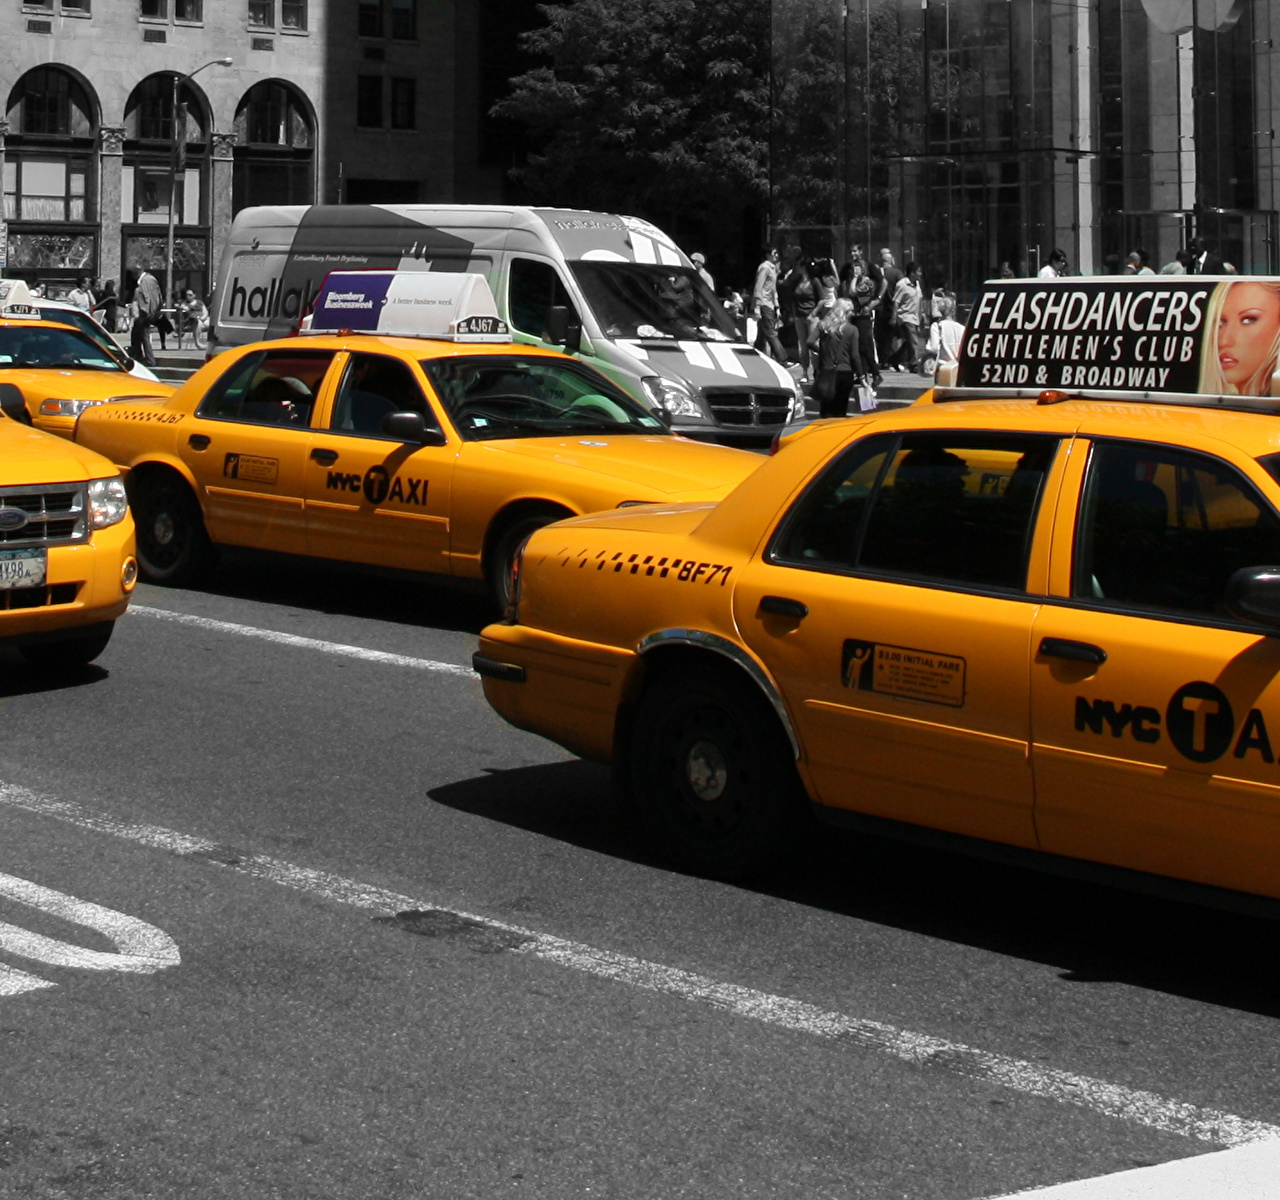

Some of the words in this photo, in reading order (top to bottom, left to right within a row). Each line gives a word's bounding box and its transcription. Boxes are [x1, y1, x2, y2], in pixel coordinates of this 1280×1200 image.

[327, 291, 365, 301] Bloomberg
[470, 318, 493, 332] 4J67
[973, 290, 1208, 332] FLASHDANCERS
[967, 333, 1121, 361] GENTLEMEN'S
[1135, 336, 1194, 362] CLUB
[980, 364, 1029, 385] 52ND
[1035, 366, 1049, 386] &
[1060, 365, 1171, 389] BROADWAY
[326, 471, 361, 493] NYC
[362, 464, 429, 506] TAXI
[676, 560, 734, 587] 8F71
[1074, 695, 1161, 744] NYC
